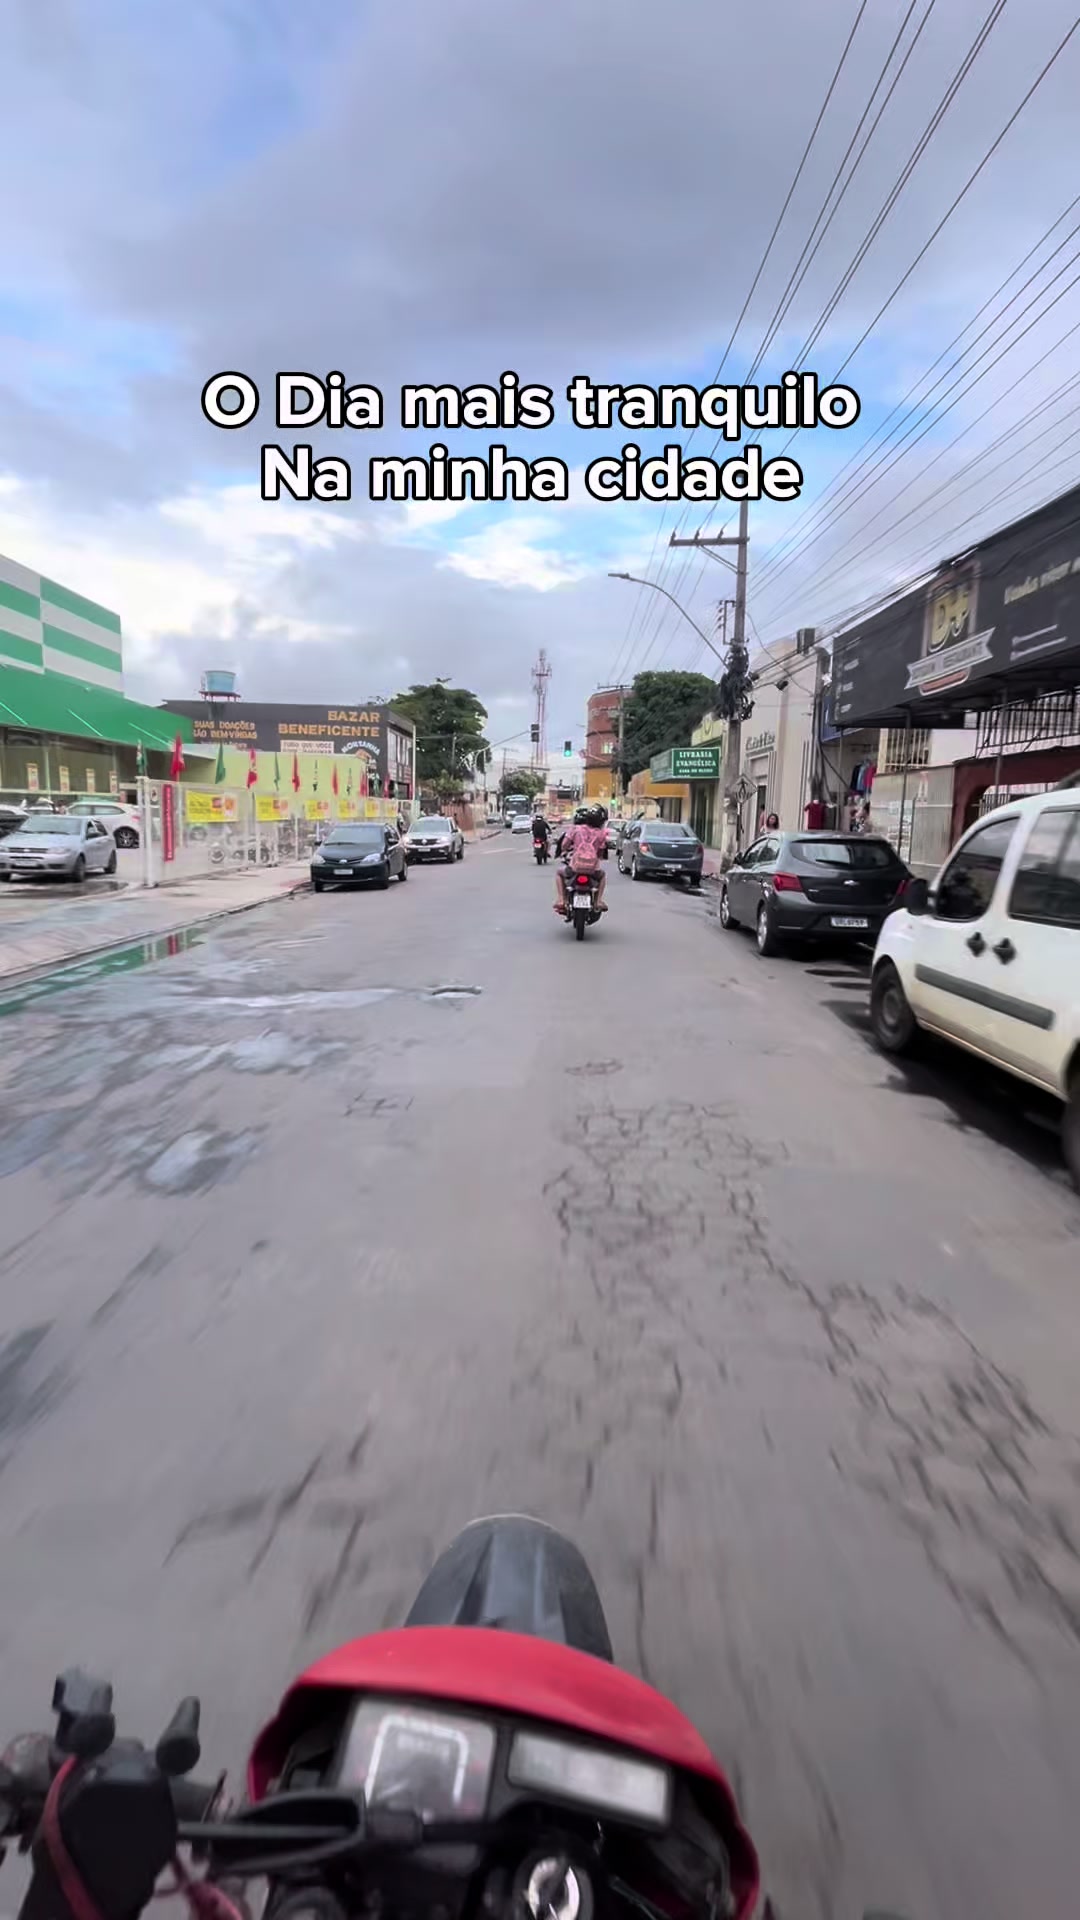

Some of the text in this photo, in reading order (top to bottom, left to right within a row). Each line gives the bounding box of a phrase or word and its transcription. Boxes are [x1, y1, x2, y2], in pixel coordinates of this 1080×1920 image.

[327, 710, 380, 722] BAZAR
[278, 723, 380, 737] BENEFICENTE
[675, 758, 717, 767] EVANGÉLICA
